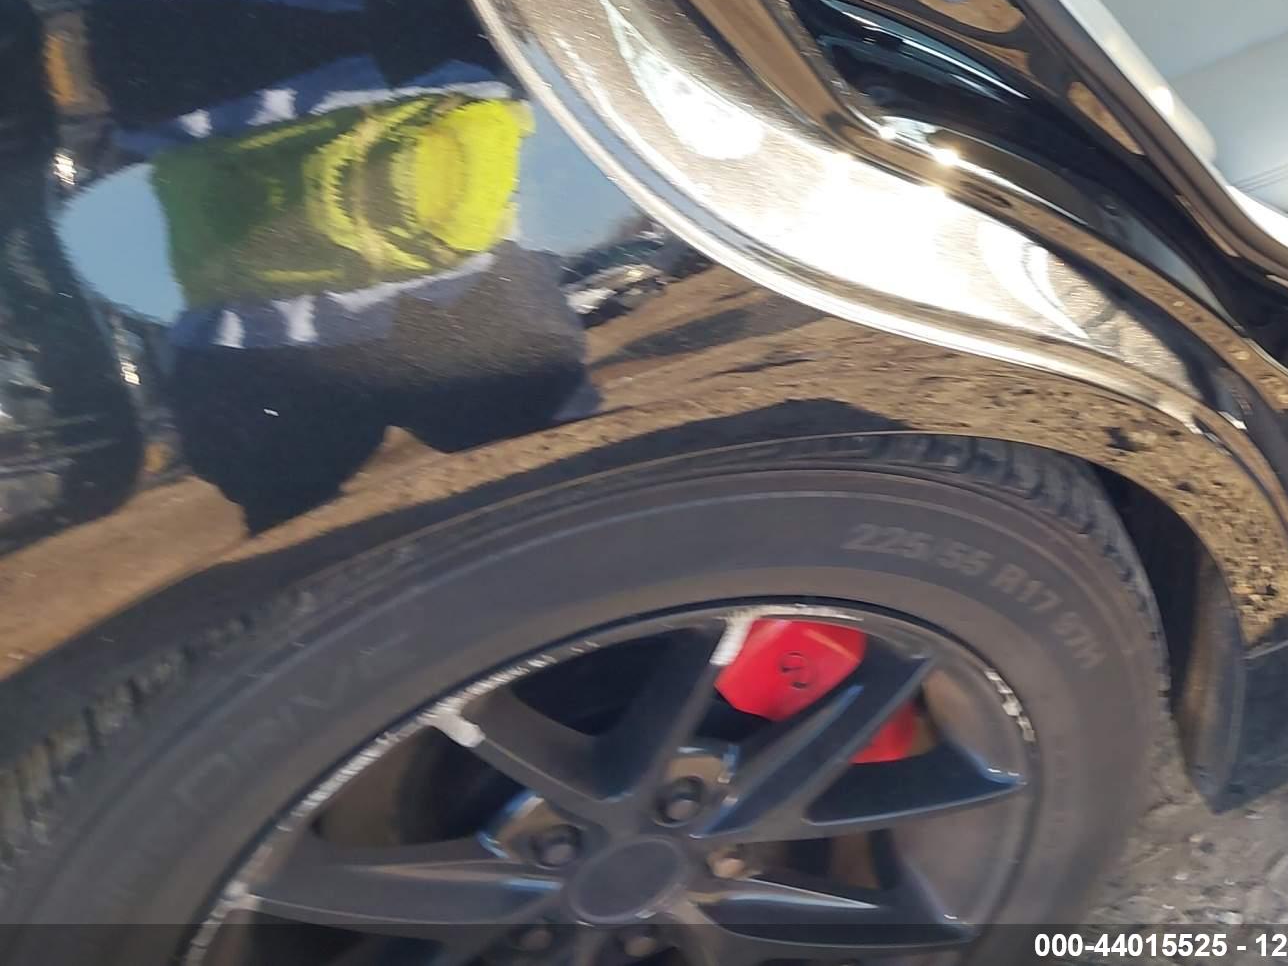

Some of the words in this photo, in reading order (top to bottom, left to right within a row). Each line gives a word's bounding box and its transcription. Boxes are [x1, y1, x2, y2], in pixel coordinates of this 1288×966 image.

[840, 523, 935, 562] 225
[935, 537, 996, 577] 55
[988, 563, 1064, 614] R17
